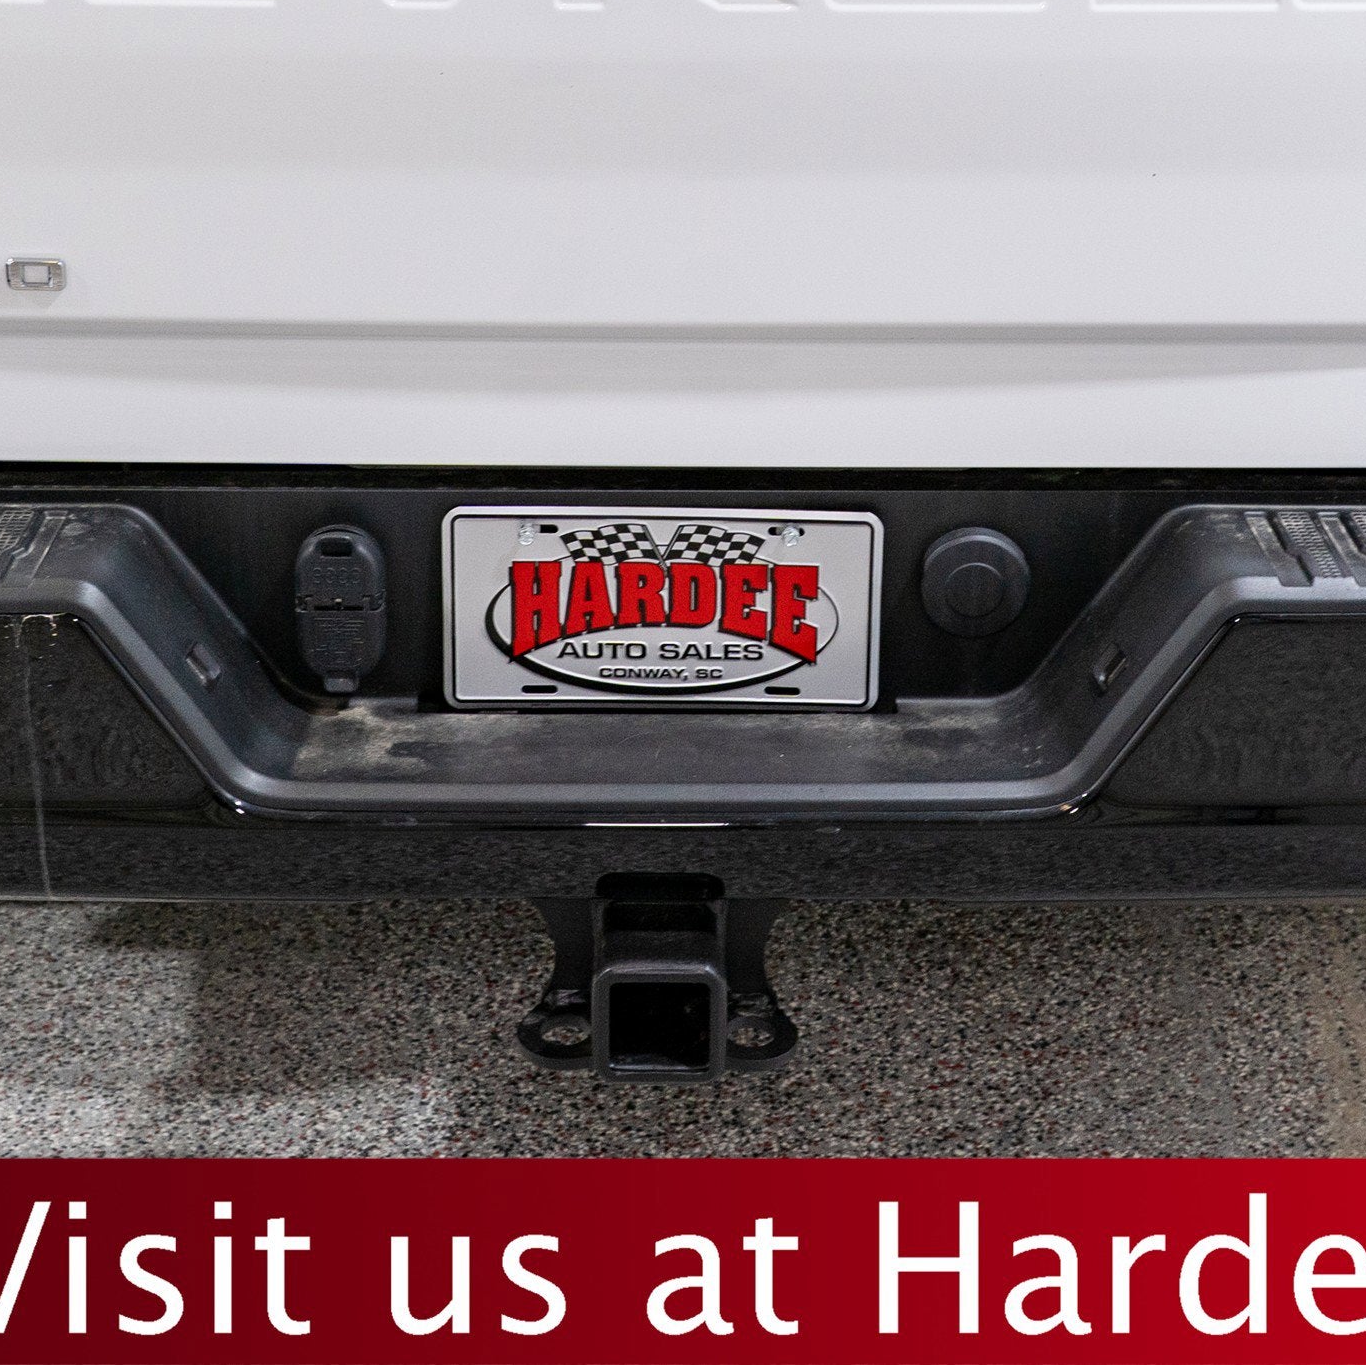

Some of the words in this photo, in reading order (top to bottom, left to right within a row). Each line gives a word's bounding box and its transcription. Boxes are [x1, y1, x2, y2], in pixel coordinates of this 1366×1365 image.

[508, 559, 820, 665] HARDEE
[557, 641, 647, 661] AUTO
[658, 641, 765, 662] SALES
[598, 666, 689, 681] CONWAY,
[695, 667, 724, 679] SC
